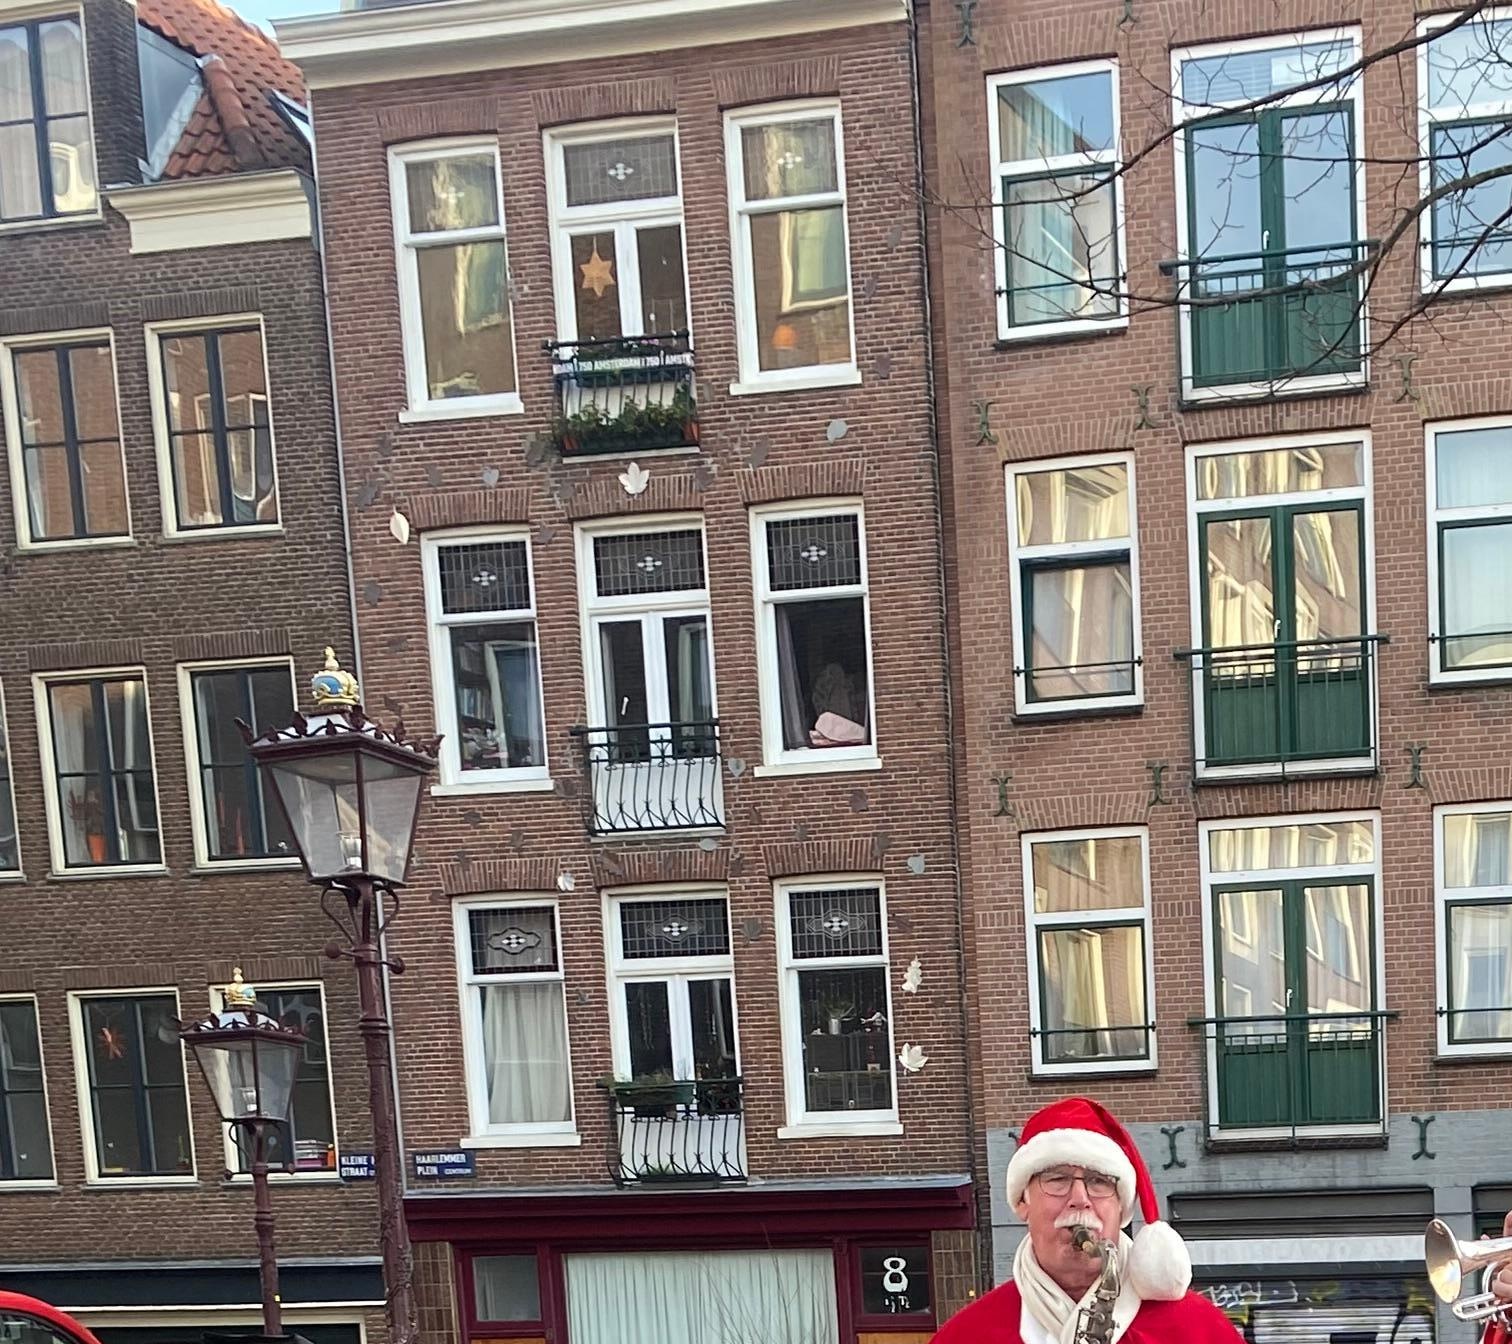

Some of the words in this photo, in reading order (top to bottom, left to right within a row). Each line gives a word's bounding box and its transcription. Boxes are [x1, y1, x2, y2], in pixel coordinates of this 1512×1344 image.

[594, 358, 641, 370] AMSTERDAM
[415, 1153, 466, 1165] HAARLEMMER
[341, 1166, 368, 1177] STRAAT
[416, 1165, 438, 1175] PLEIN
[883, 1256, 909, 1293] 8
